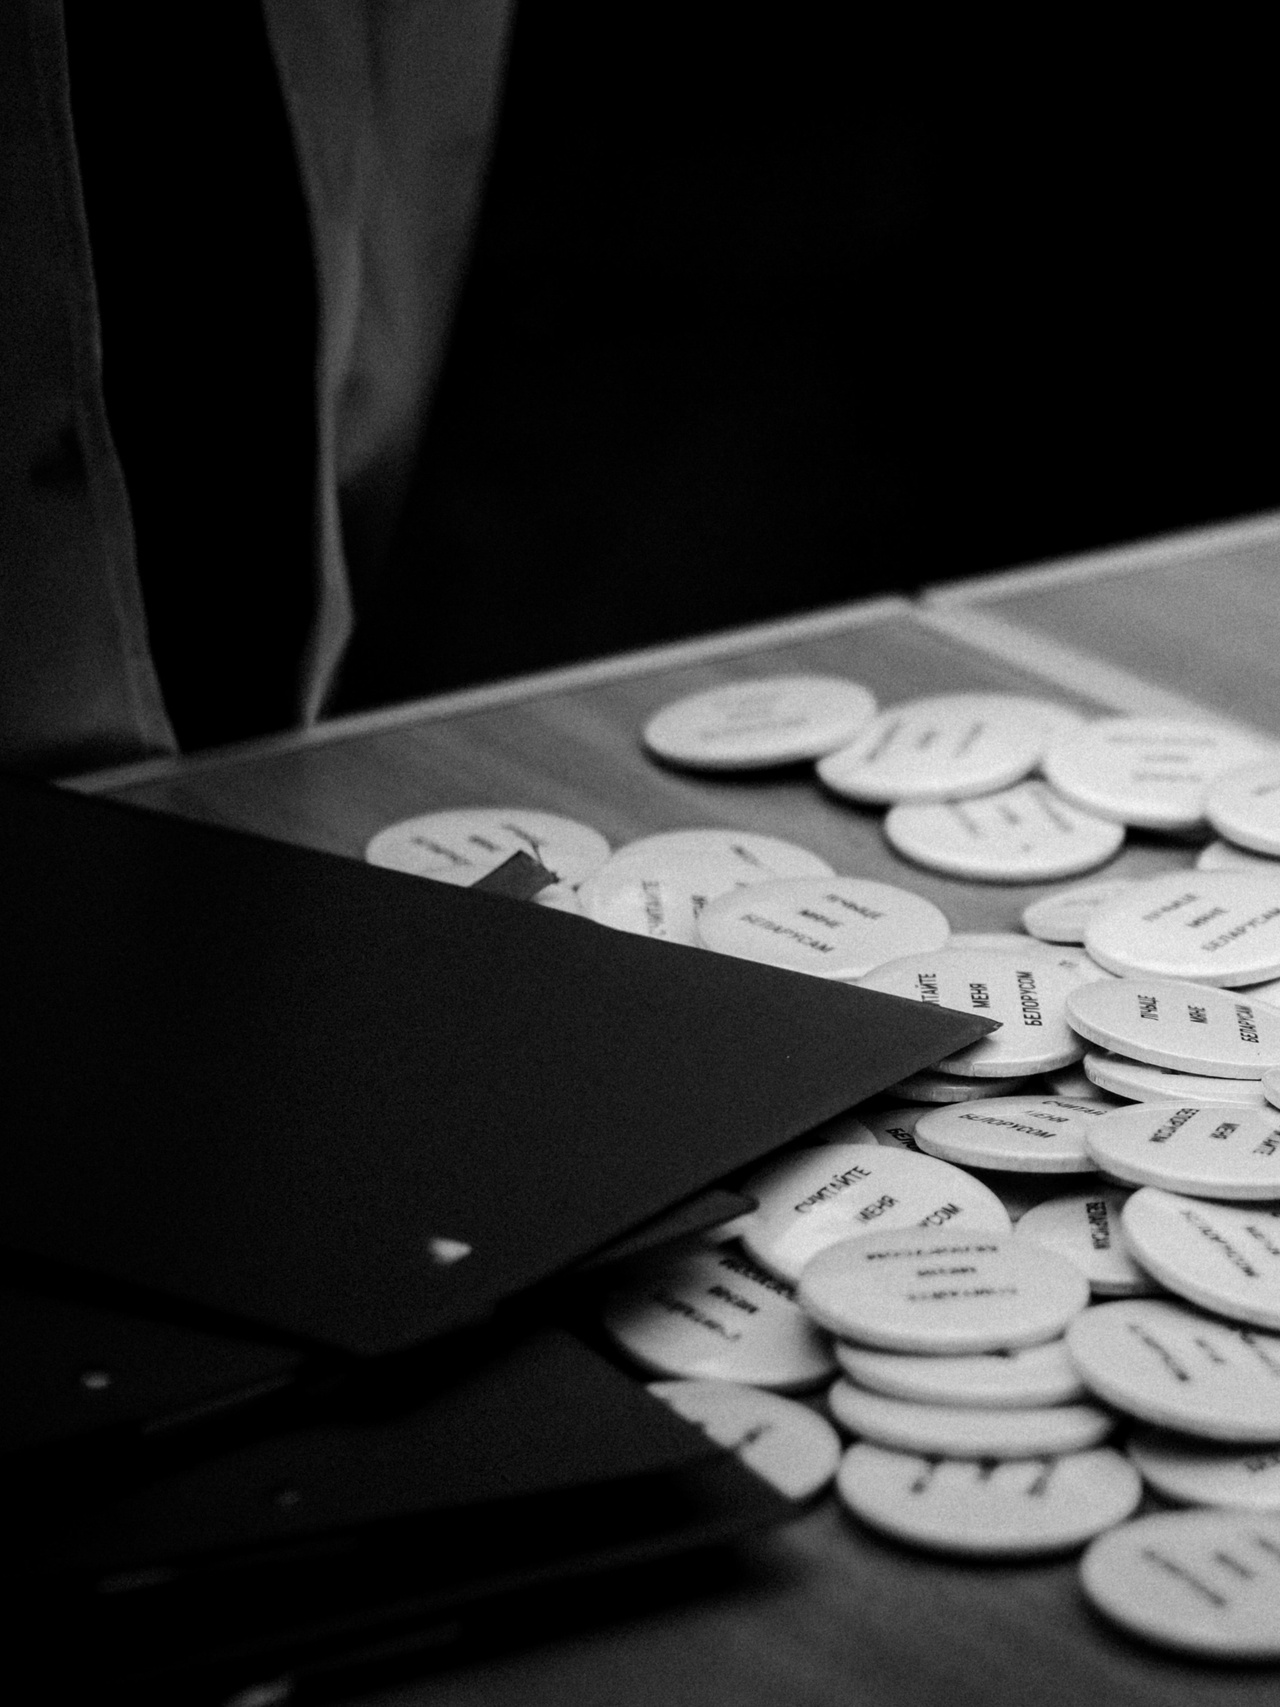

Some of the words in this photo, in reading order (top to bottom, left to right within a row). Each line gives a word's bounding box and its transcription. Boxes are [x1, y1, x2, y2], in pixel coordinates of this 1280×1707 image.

[969, 982, 991, 1010] МЕНЯ
[1015, 971, 1043, 1027] БЕЛОРУСОМ
[1041, 1100, 1109, 1117] СЧИТАЙ
[957, 1112, 1058, 1139] БЕЛОРУСОМ
[794, 1165, 872, 1215] СЧИТАЙТЕ
